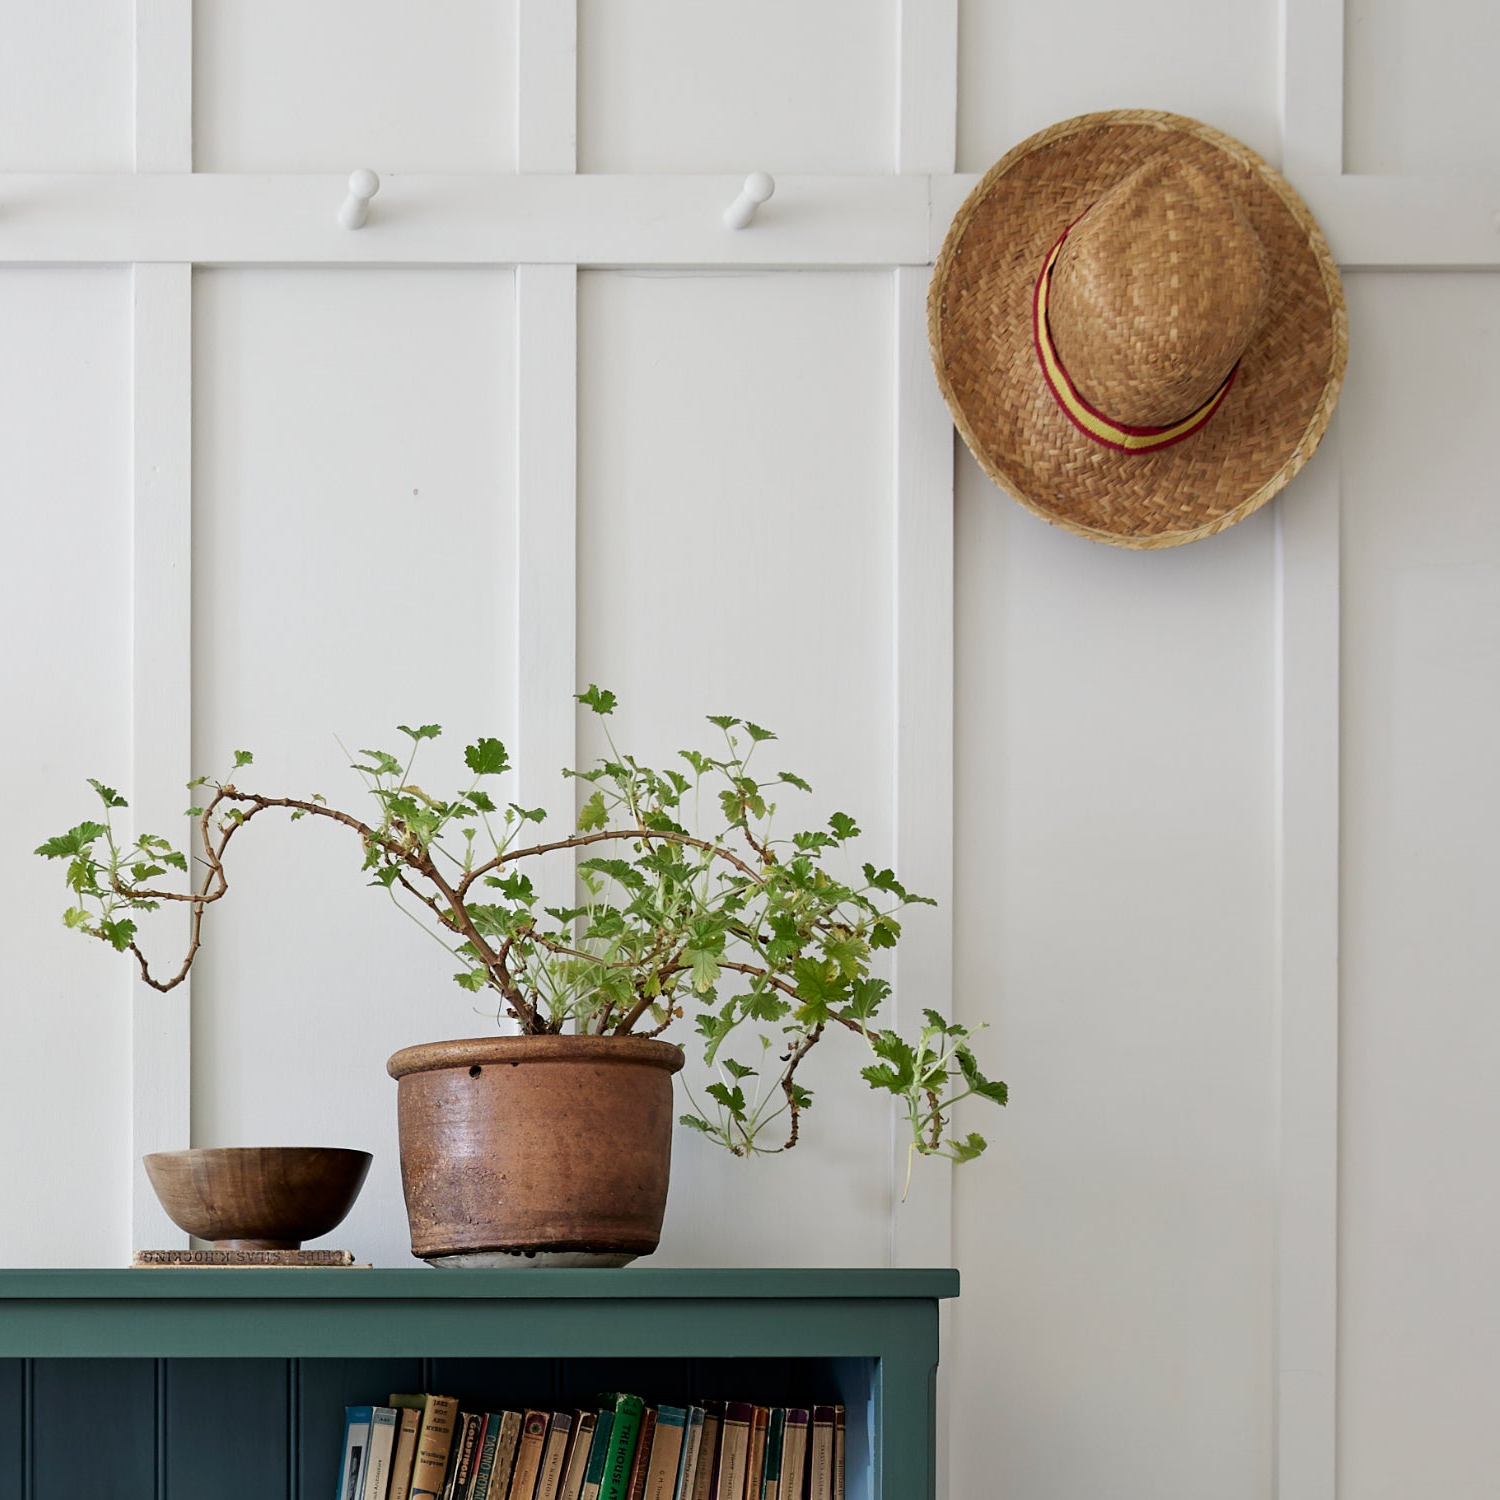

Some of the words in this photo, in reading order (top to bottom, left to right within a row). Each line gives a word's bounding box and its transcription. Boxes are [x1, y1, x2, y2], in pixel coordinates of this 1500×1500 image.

[236, 1252, 280, 1262] SILAS
[298, 1251, 342, 1262] CHIPS
[619, 1425, 631, 1450] THE
[457, 1422, 476, 1485] GOLDFINGER
[481, 1435, 496, 1470] CASINO
[610, 1447, 626, 1485] HOUSE
[544, 1468, 554, 1497] GOLDEN
[607, 1488, 617, 1500] AT
